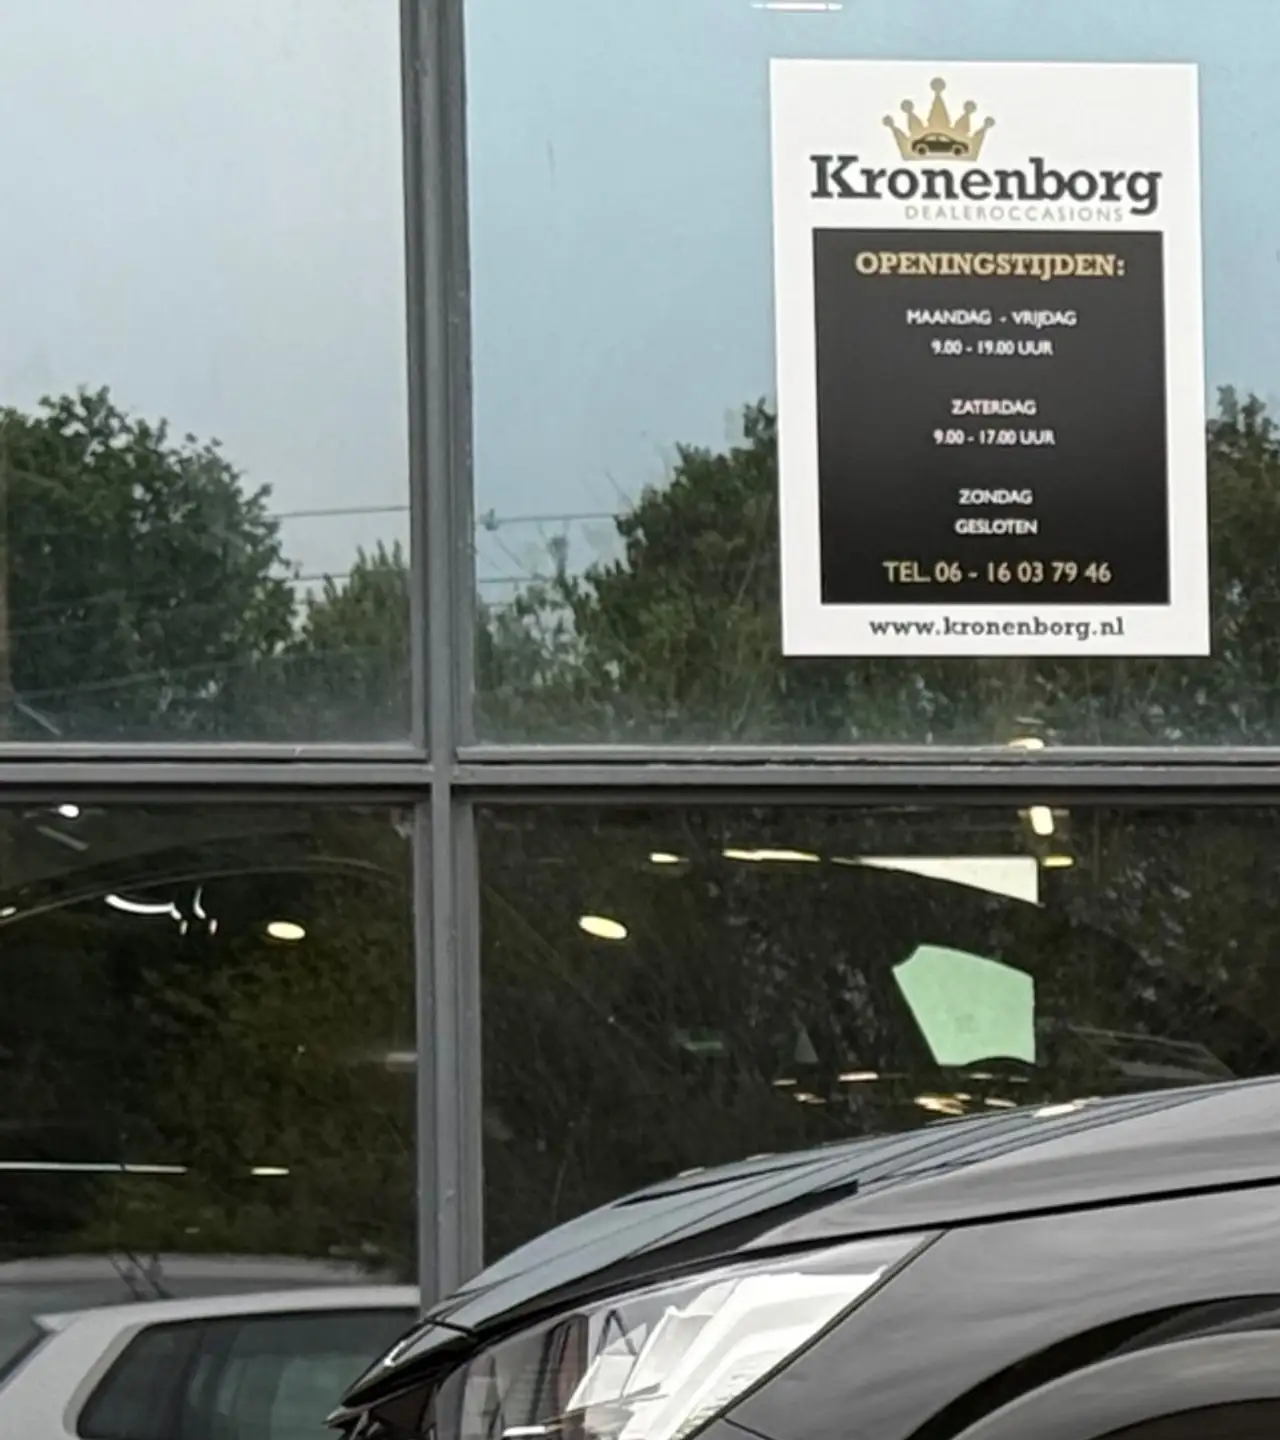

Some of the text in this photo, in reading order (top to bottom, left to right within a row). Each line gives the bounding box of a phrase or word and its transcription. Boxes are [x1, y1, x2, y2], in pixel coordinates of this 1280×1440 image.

[810, 154, 1163, 216] Kronenborg
[905, 206, 1123, 223] DEALEROCCASIONS
[855, 252, 1126, 281] OPENINGSTIJDEN:
[906, 309, 992, 325] MAANDAG
[1011, 310, 1077, 329] VRIJDAG
[931, 339, 963, 355] 9.00
[977, 340, 1015, 355] 19.00
[1017, 340, 1053, 356] UUR
[951, 398, 1037, 415] ZATERDAG
[933, 429, 965, 445] 9.00
[979, 430, 1017, 445] 17.00
[1019, 430, 1056, 445] UUR
[958, 489, 1033, 505] ZONDAG
[954, 518, 1038, 535] GESLOTEN
[934, 561, 962, 583] 06
[987, 561, 1011, 583] 16
[1017, 561, 1044, 583] 03
[1051, 561, 1078, 583] 79
[1084, 561, 1112, 583] 46
[869, 616, 1126, 641] www.kronenborg.nl
